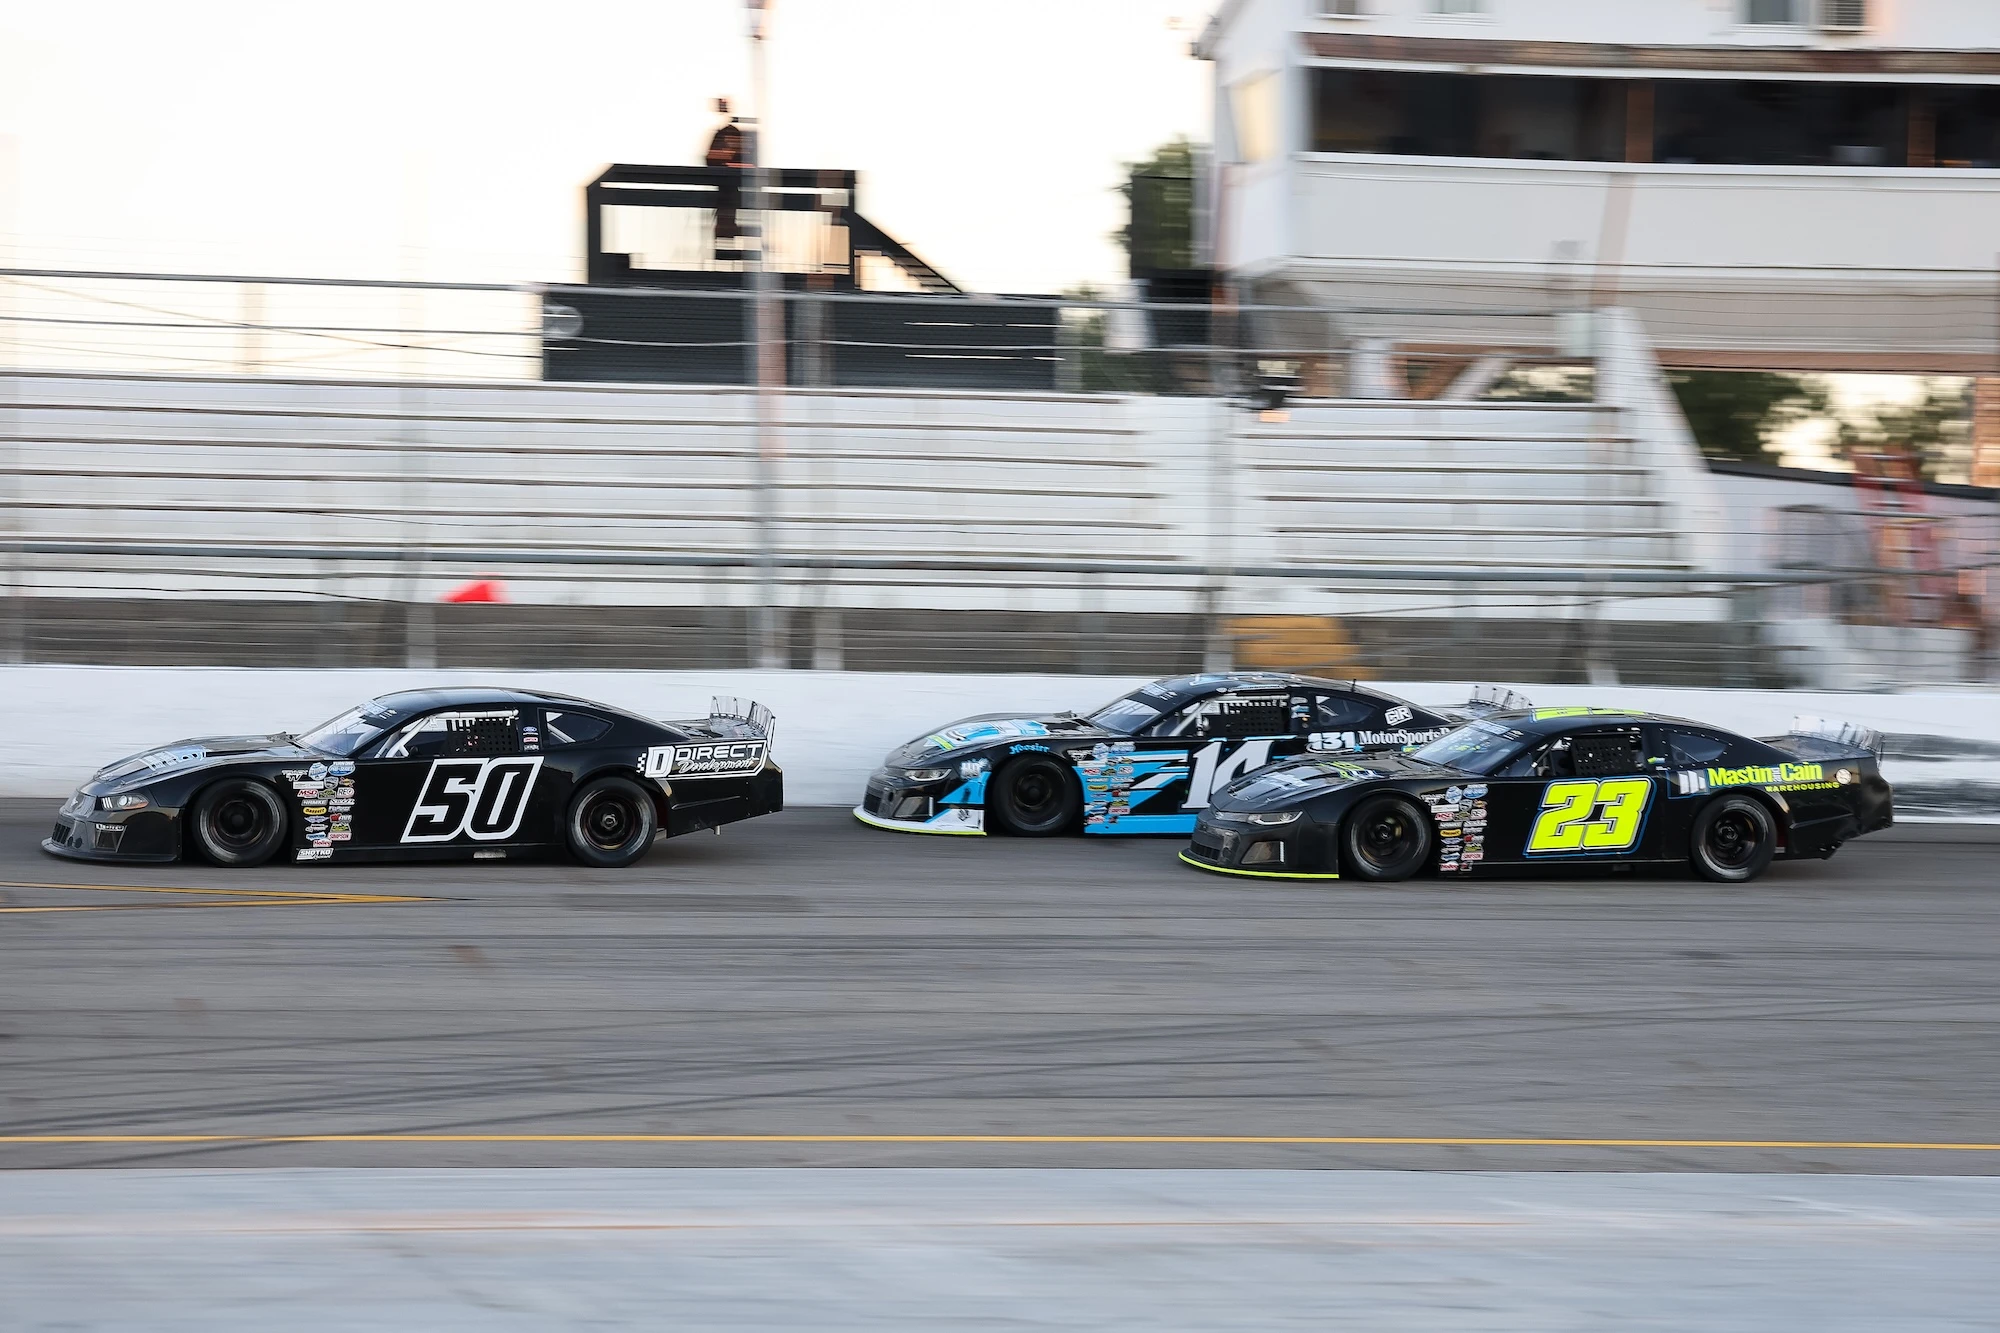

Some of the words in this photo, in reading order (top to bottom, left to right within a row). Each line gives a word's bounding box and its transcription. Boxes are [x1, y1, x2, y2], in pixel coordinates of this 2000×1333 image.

[1307, 731, 1356, 750] 131
[675, 744, 763, 761] DIRECT
[678, 757, 760, 774] Development
[1707, 765, 1774, 786] Mastin
[1779, 762, 1823, 783] Cain
[1765, 781, 1841, 793] WAREHOUSING
[400, 756, 545, 843] 50
[1526, 777, 1653, 853] 23
